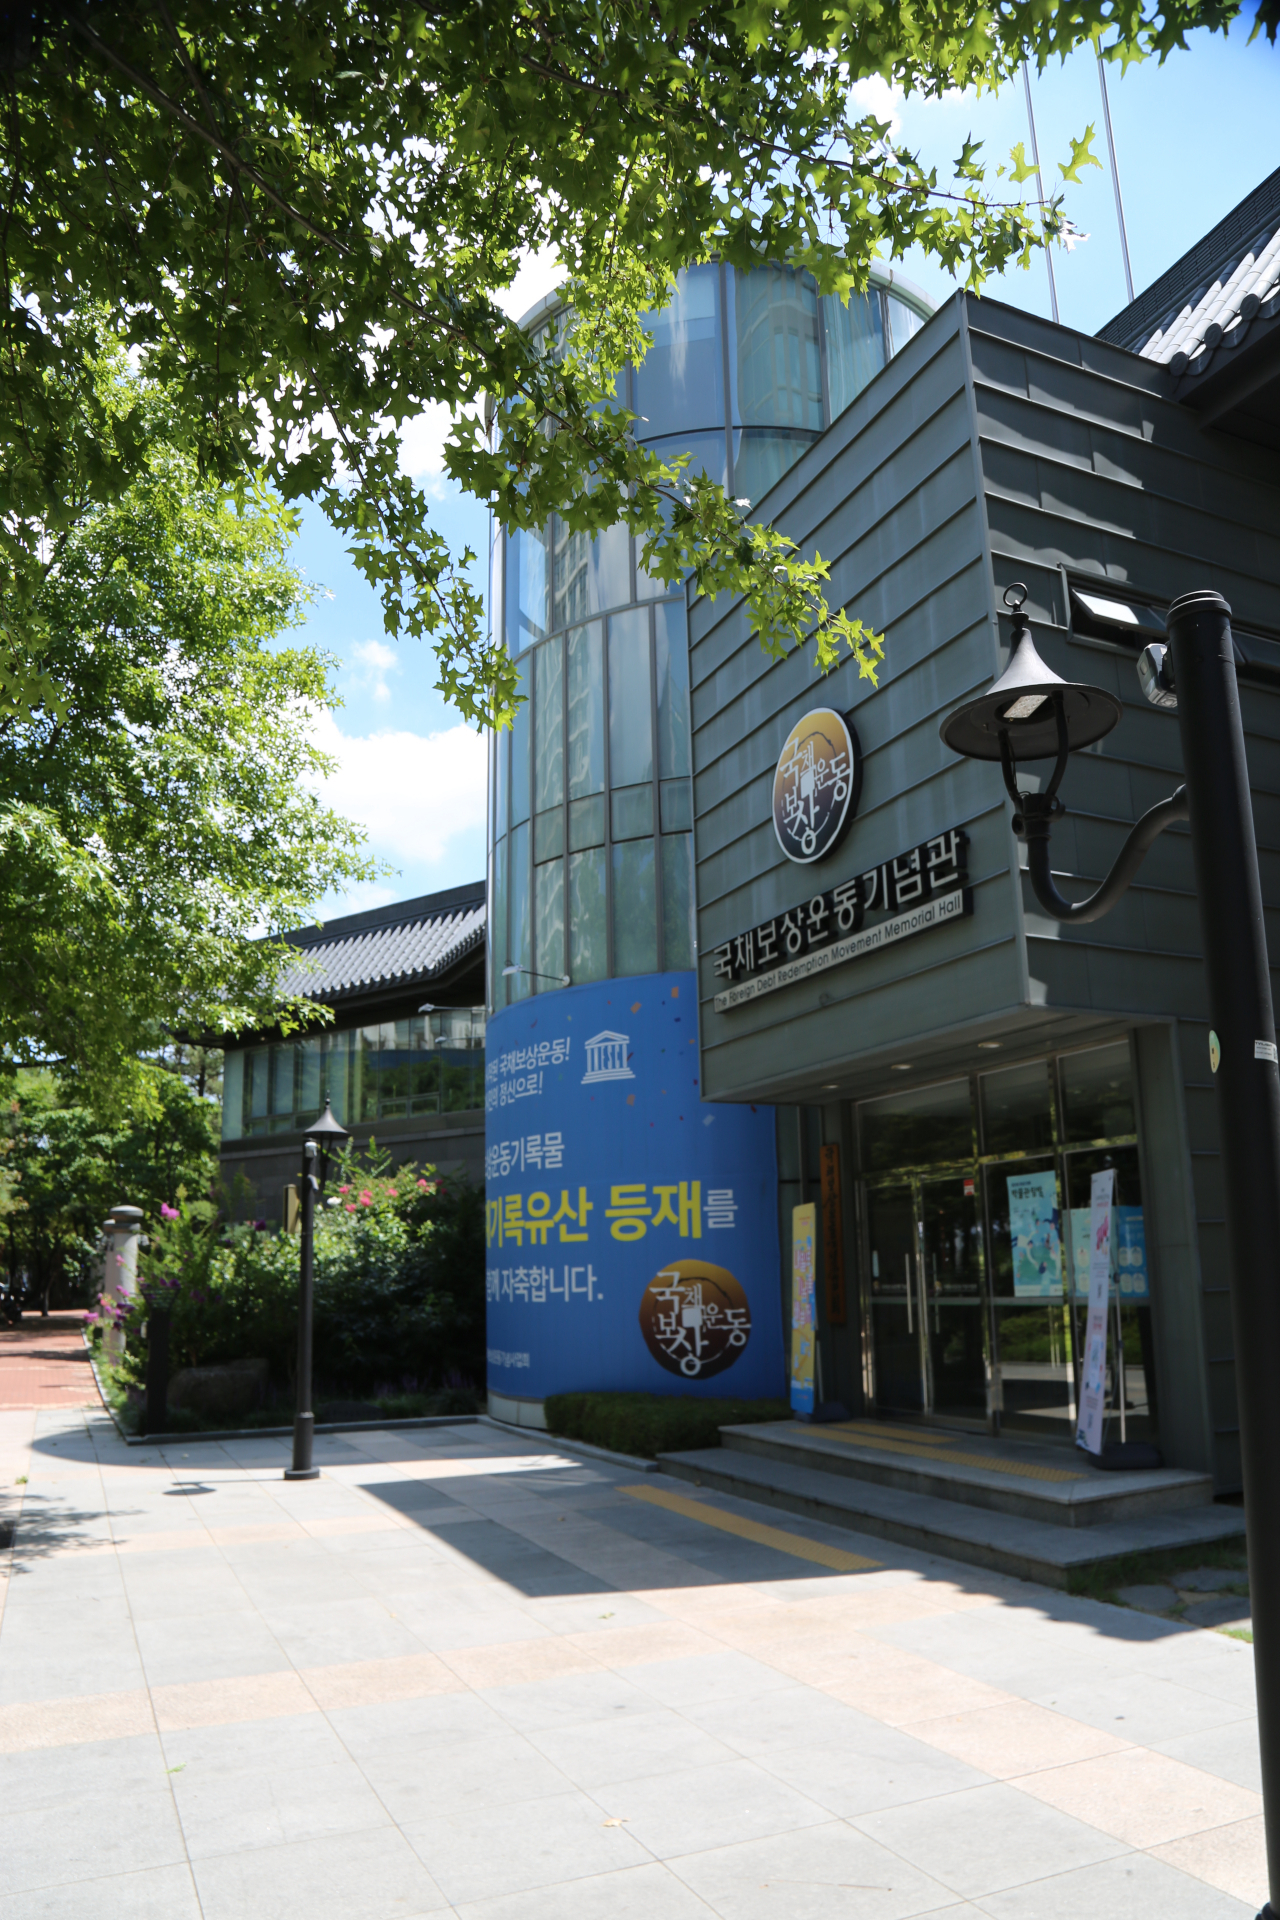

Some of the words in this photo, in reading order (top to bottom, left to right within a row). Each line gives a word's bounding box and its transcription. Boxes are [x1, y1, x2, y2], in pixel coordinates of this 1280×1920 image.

[714, 830, 960, 980] 국채보상운동기념관
[715, 994, 728, 1007] The
[729, 983, 756, 1003] Foreign
[757, 974, 777, 991] Debt
[778, 955, 830, 982] Redemption
[831, 930, 882, 961] Movement
[885, 906, 935, 939] Memorial
[939, 895, 960, 917] Hall
[500, 1036, 571, 1077] 국채보상운동!
[500, 1071, 543, 1106] 정신으로!
[502, 1264, 604, 1303] 자축합니다.
